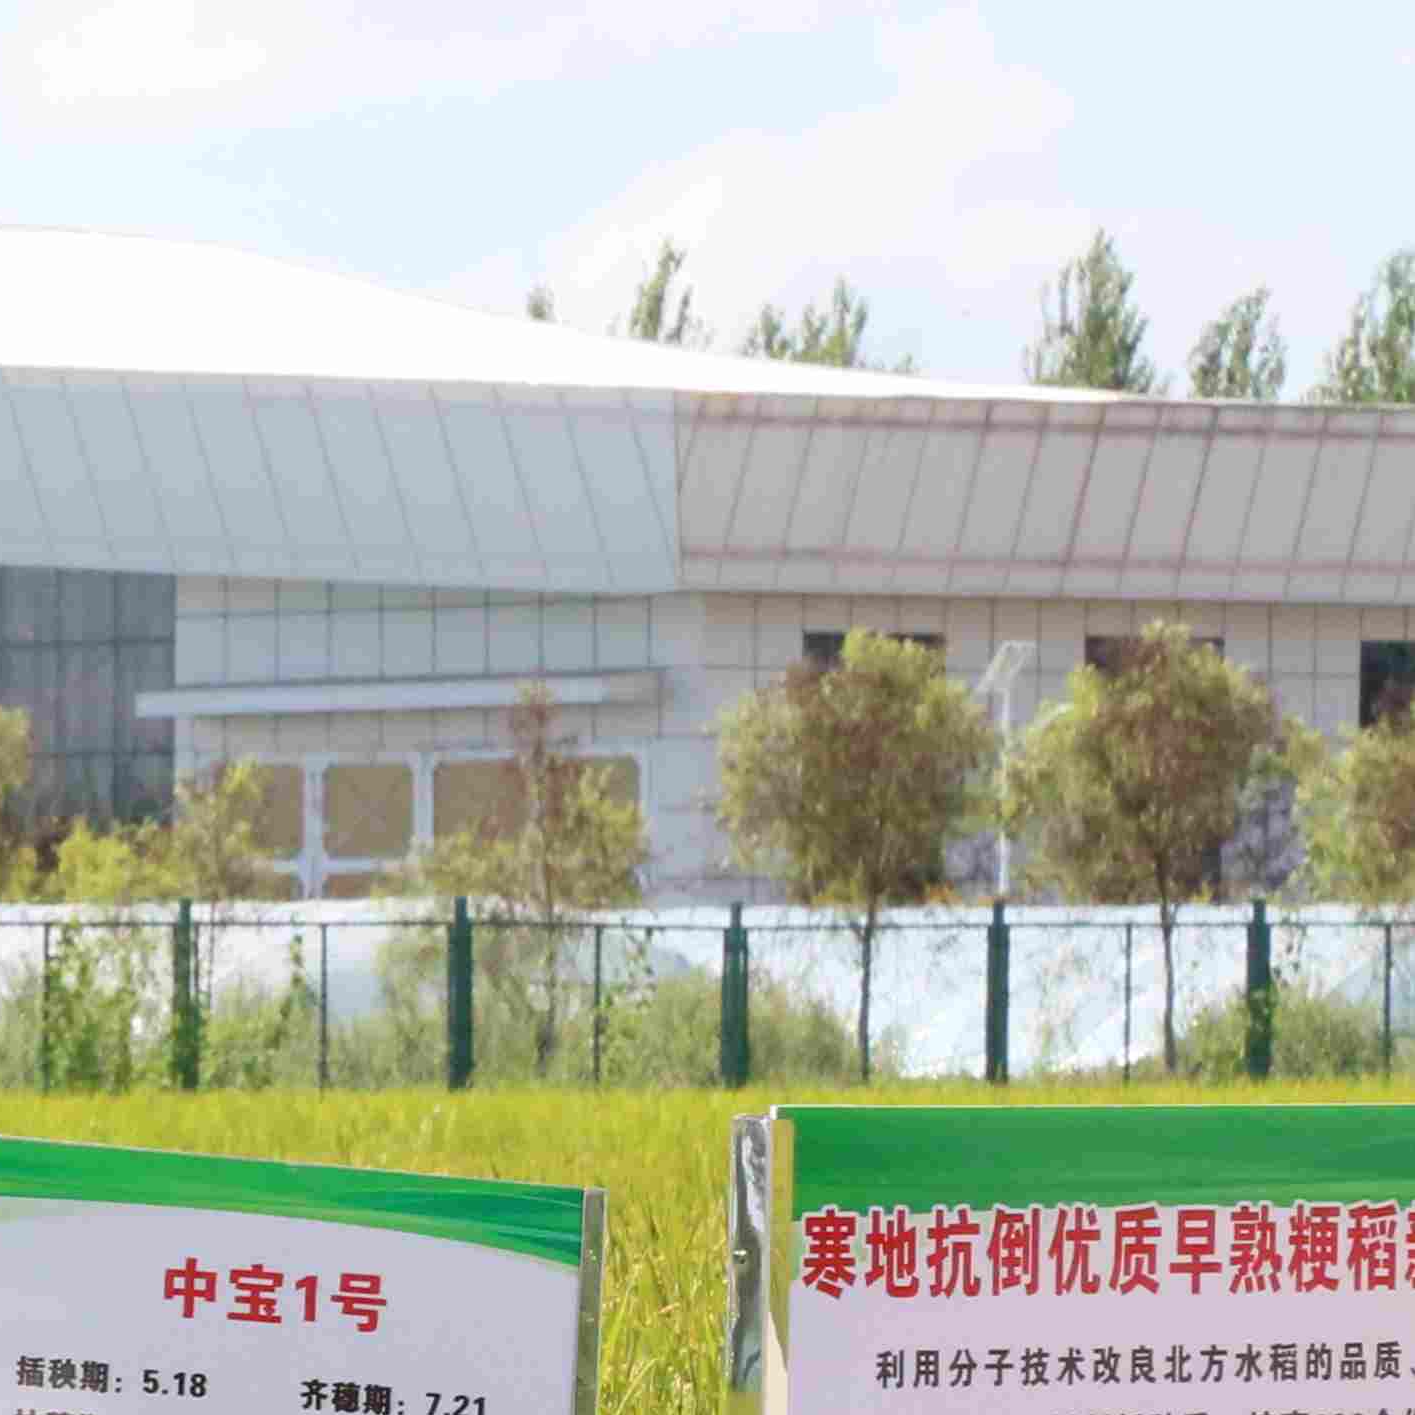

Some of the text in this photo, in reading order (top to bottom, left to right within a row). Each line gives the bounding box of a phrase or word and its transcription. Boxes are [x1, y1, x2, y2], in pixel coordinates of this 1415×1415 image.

[800, 1204, 1415, 1298] 寒地抗倒优质早熟粳稻
[163, 1257, 387, 1333] 中宝1号
